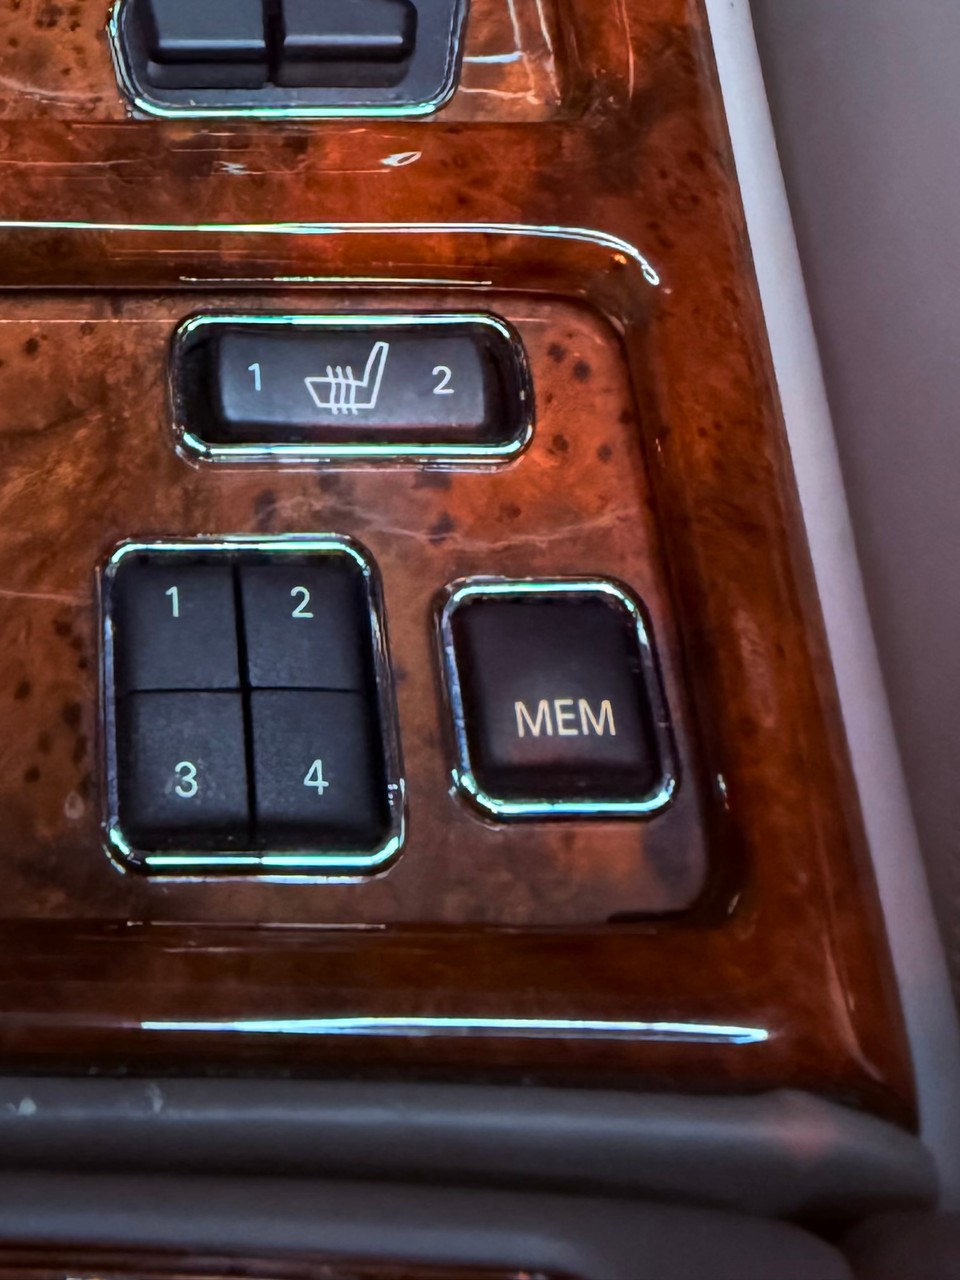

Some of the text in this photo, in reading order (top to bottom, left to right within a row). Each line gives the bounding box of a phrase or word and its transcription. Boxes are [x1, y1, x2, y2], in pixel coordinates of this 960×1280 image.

[248, 363, 455, 395] 1 2
[165, 586, 314, 618] 1 2
[514, 699, 616, 738] MEM
[174, 759, 330, 798] 3 4
